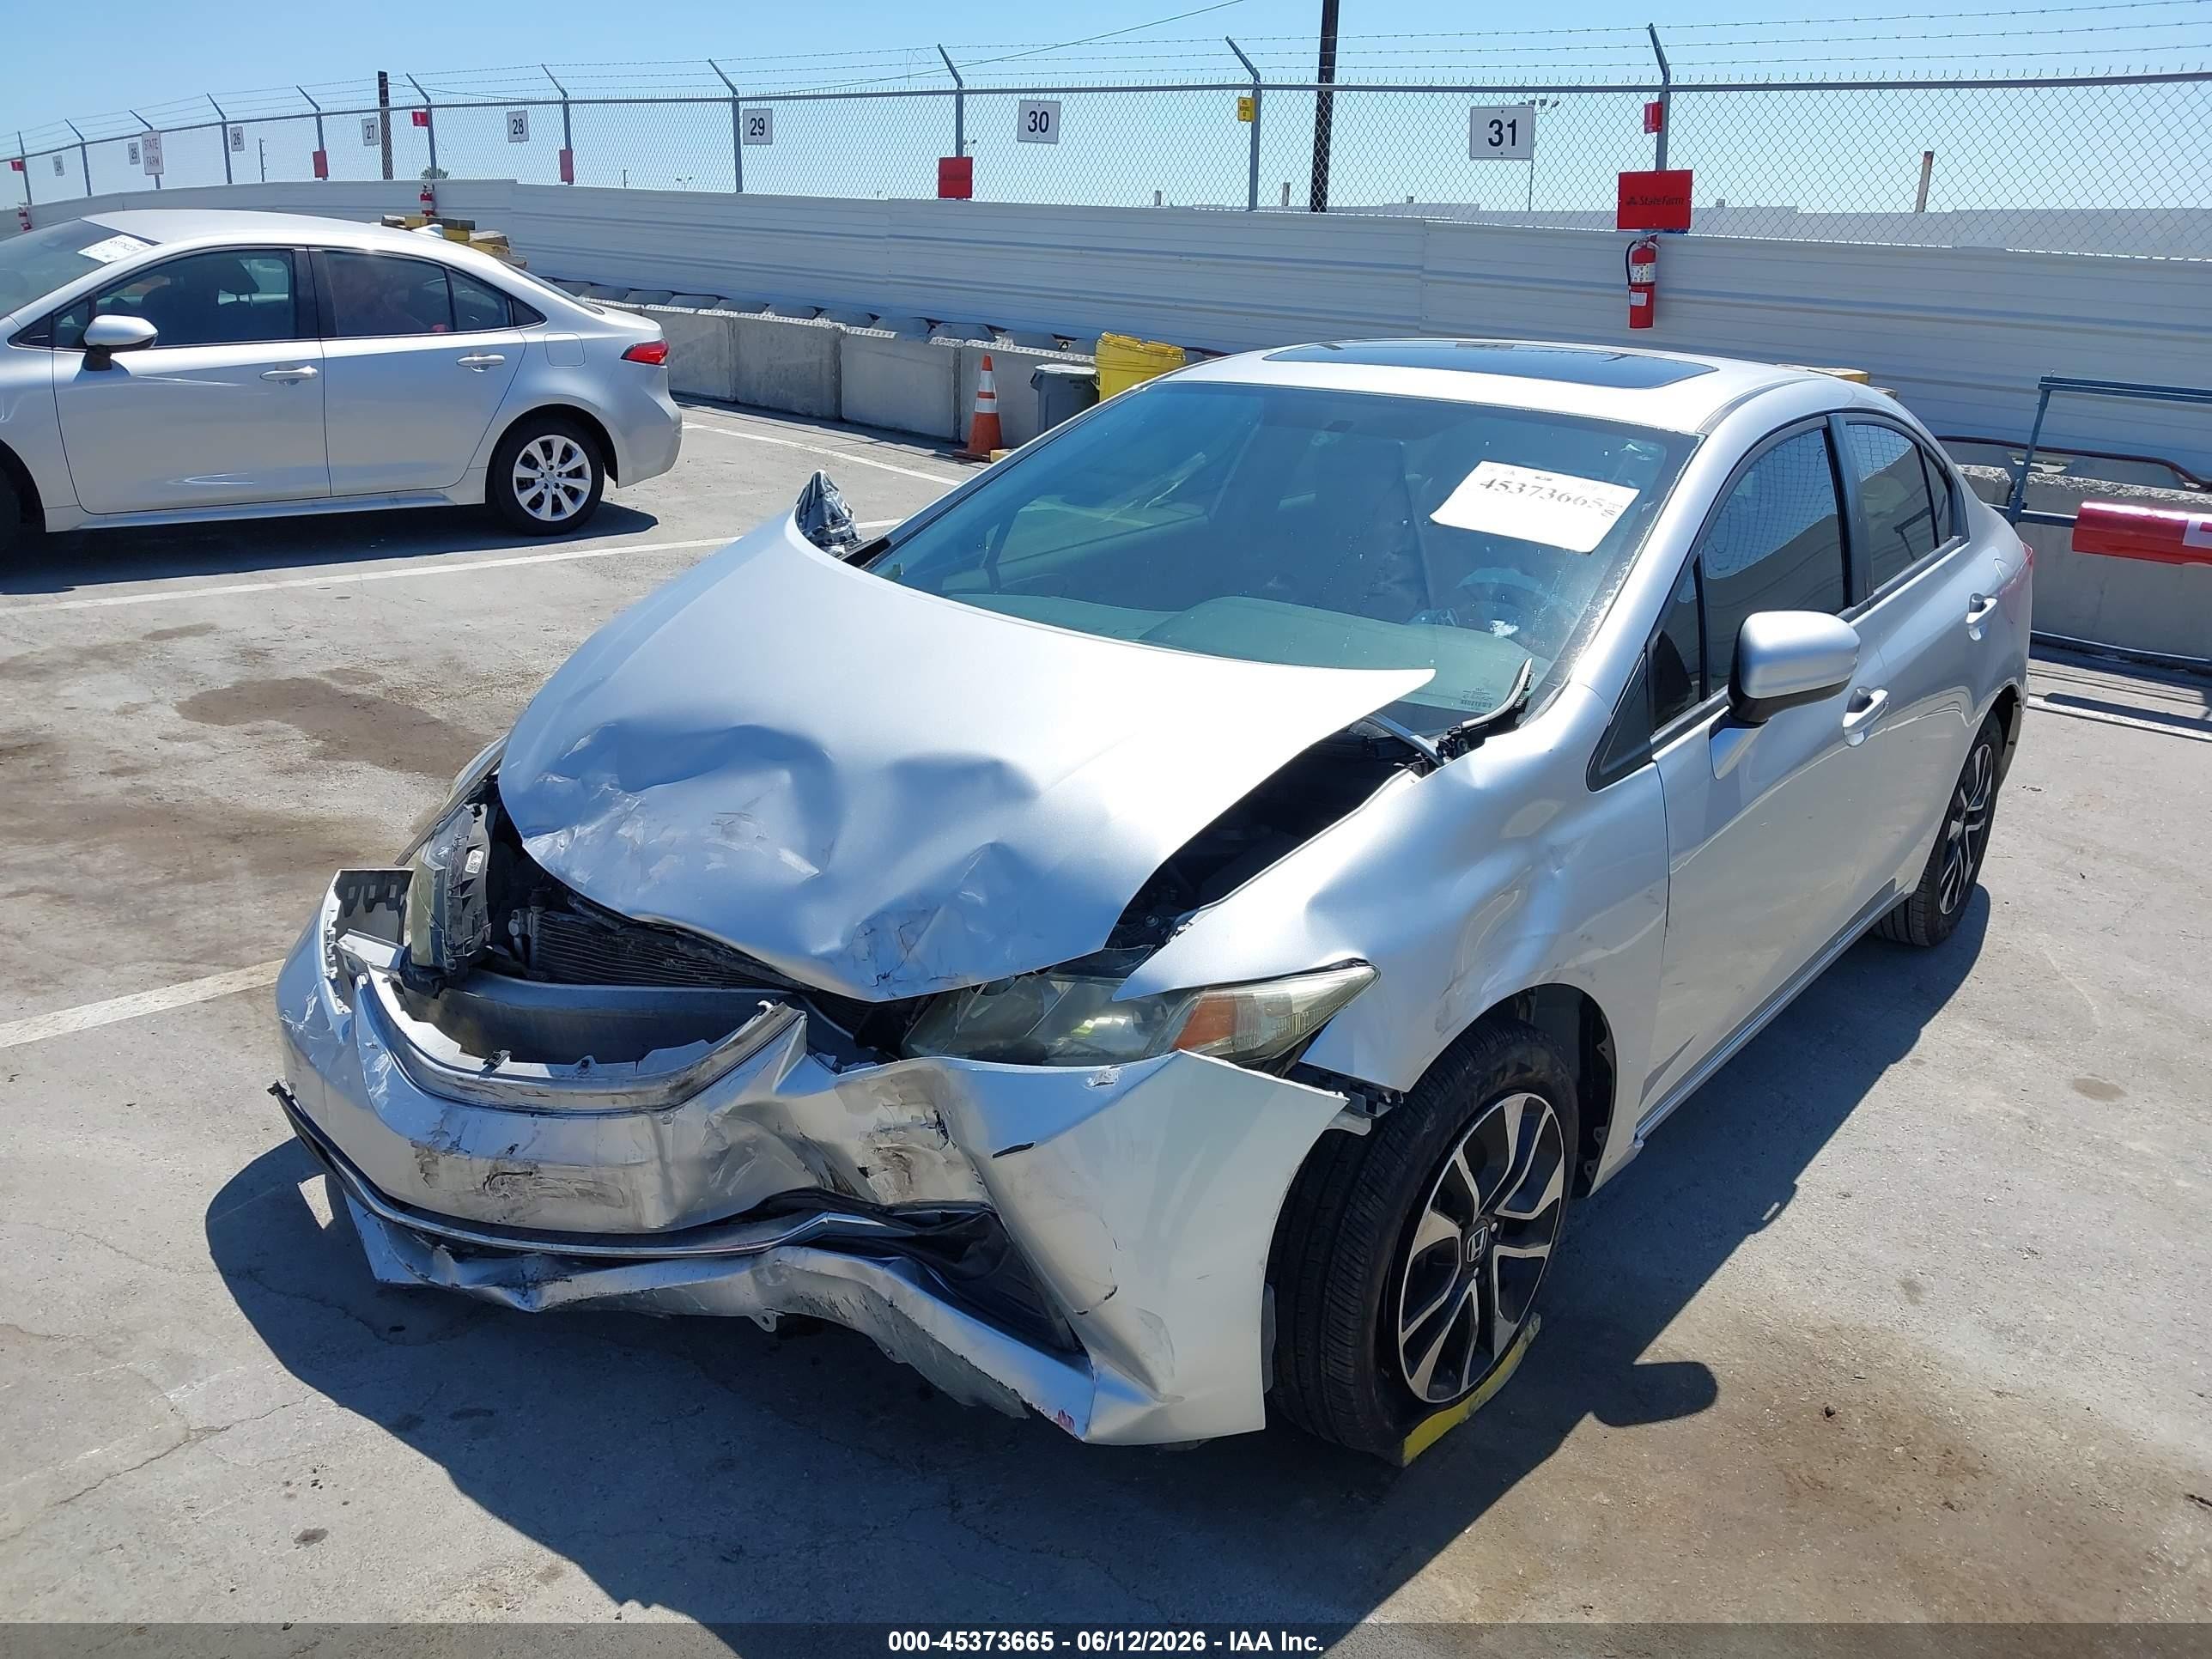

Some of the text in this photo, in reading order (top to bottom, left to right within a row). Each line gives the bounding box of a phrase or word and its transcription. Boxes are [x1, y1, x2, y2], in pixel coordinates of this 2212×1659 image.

[512, 118, 525, 135] 28
[750, 117, 765, 137] 29
[1027, 110, 1049, 134] 30
[233, 132, 241, 146] 26
[365, 125, 375, 140] 27
[1487, 118, 1517, 147] 31
[144, 138, 159, 151] STATE
[146, 155, 161, 167] FARM
[1479, 477, 1606, 509] 45373665
